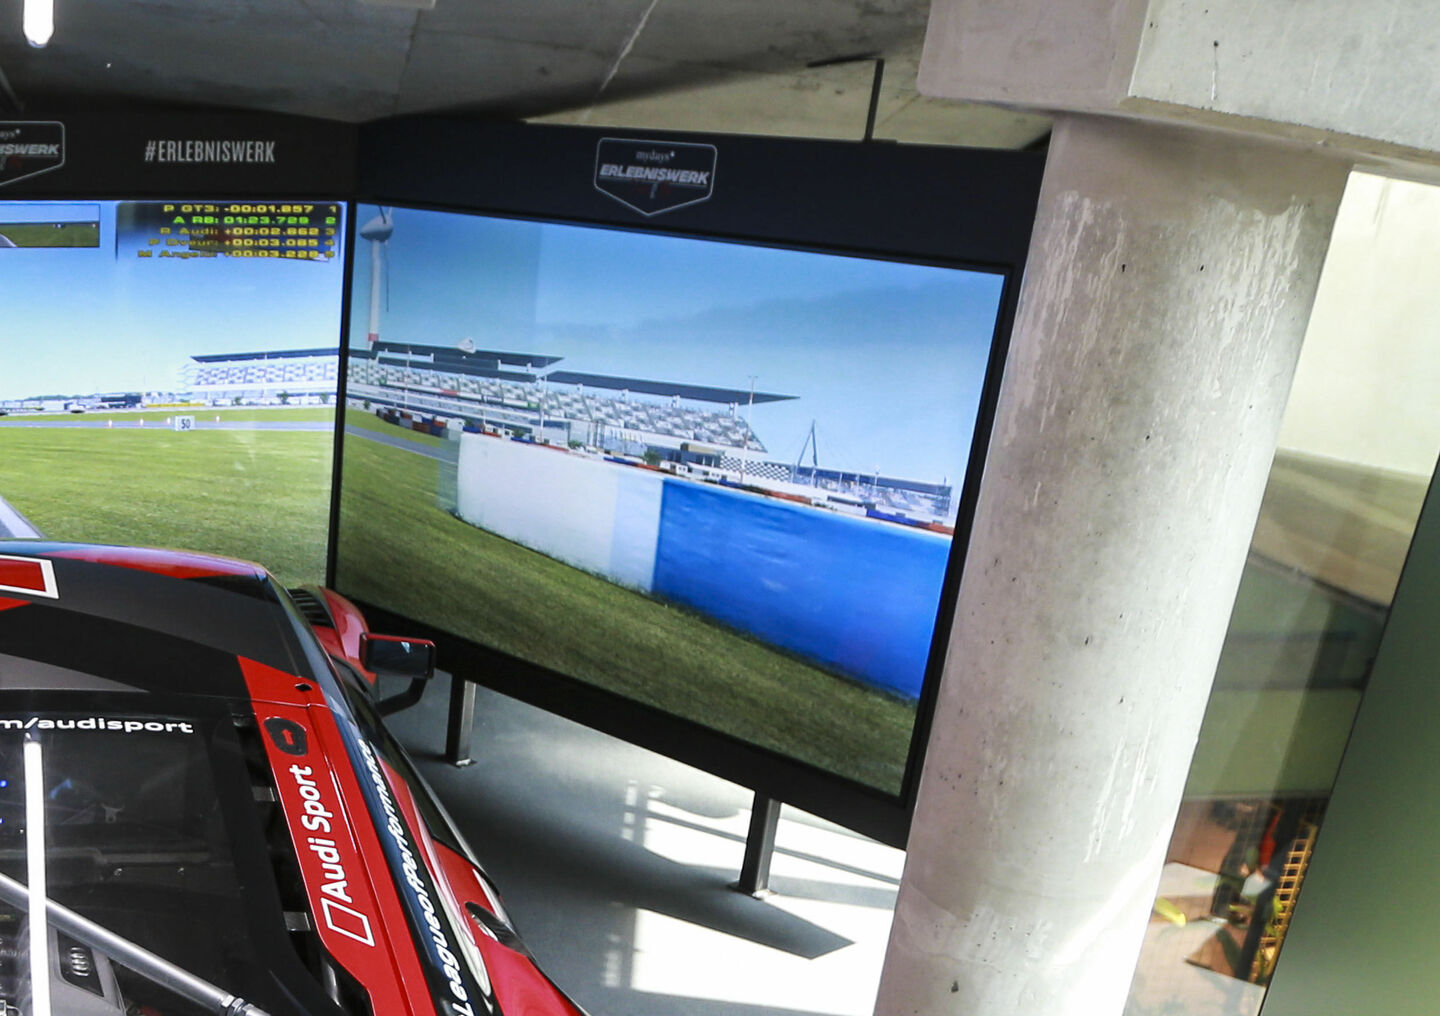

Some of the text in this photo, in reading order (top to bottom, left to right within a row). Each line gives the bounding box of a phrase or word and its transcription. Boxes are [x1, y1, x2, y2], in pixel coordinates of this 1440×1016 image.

[144, 140, 276, 163] #ERLEBNISWERK
[599, 163, 710, 185] ERLEBNISWERK
[163, 204, 175, 213] P
[181, 204, 219, 213] GT3:
[329, 205, 337, 213] 1
[173, 216, 185, 224] A
[325, 227, 335, 236] 3
[324, 239, 335, 247] 4
[181, 418, 191, 429] 50
[289, 764, 353, 904] Audi Sport
